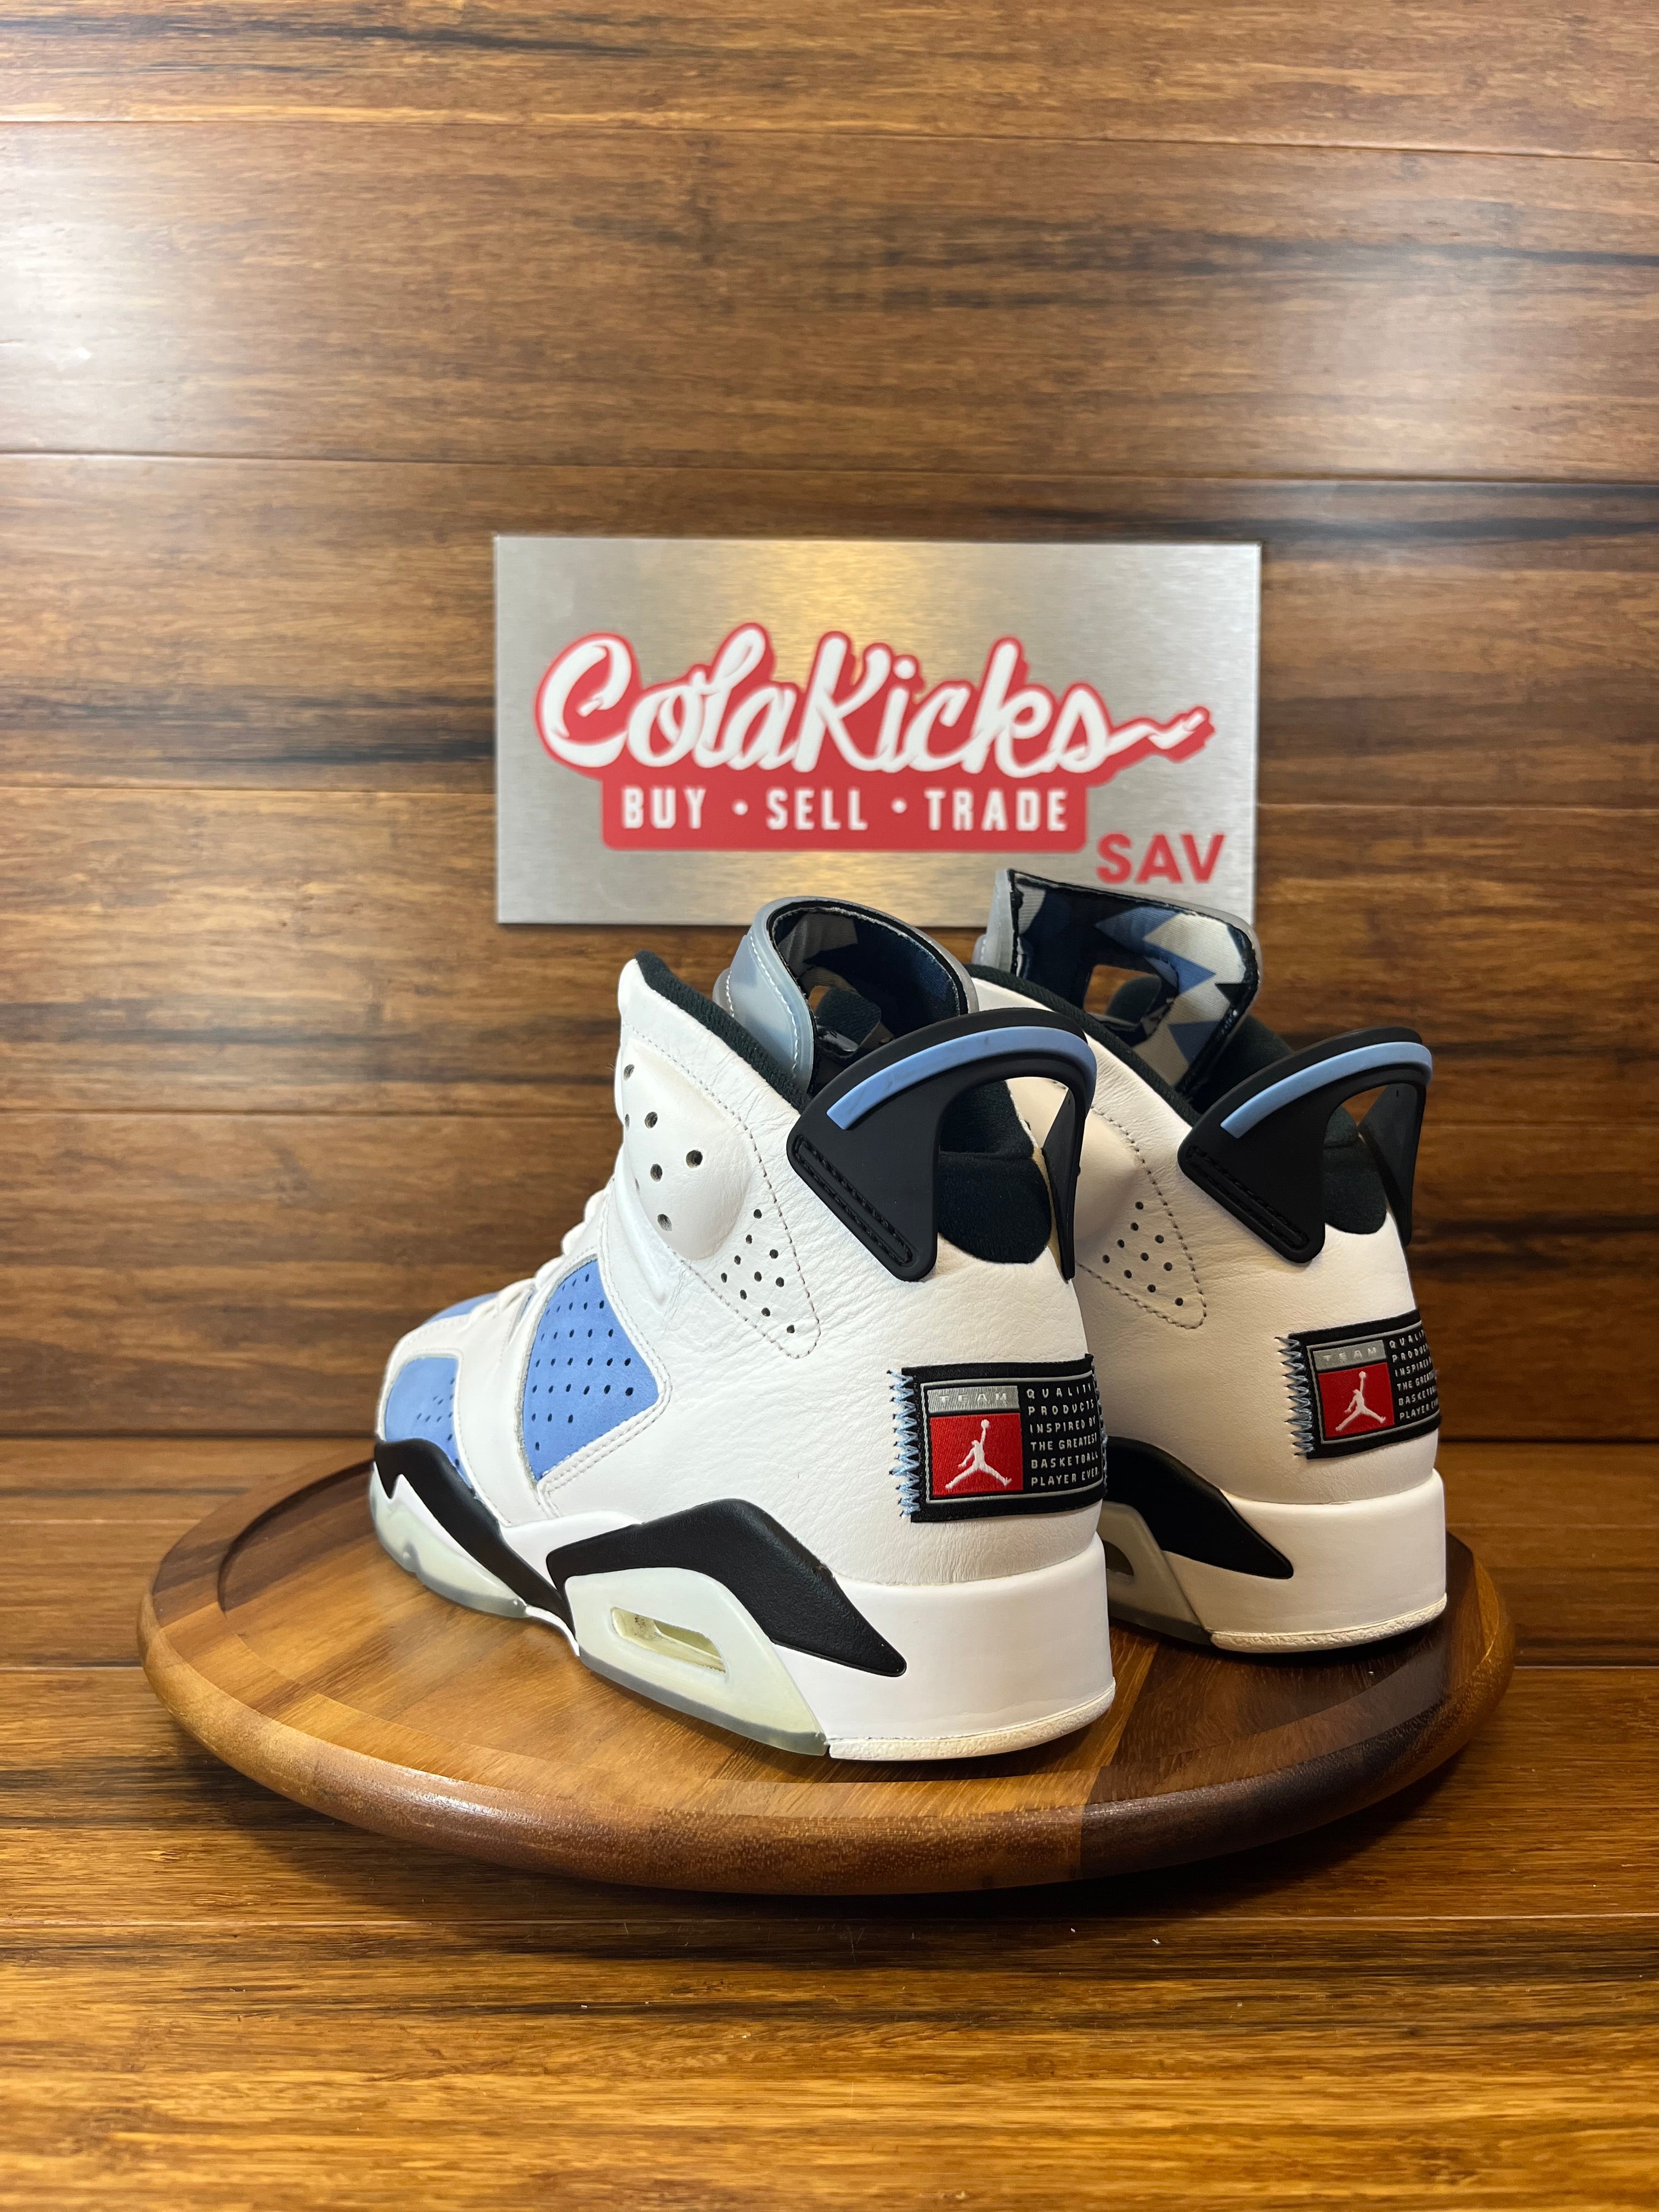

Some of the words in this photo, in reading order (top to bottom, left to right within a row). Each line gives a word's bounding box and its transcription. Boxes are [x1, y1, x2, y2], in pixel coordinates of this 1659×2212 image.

[542, 625, 1206, 779] ColaKicks
[621, 787, 706, 830] BUY
[766, 788, 868, 831] SELL
[925, 788, 1069, 831] TRADE
[1097, 833, 1226, 884] SAV
[1389, 1329, 1425, 1349] QUALIT
[1323, 1347, 1377, 1362] TEAM
[1392, 1343, 1428, 1363] PRODUC
[1026, 1383, 1092, 1400] QUALITY
[1397, 1380, 1413, 1391] THE
[939, 1392, 1007, 1406] TEAM
[1028, 1399, 1094, 1416] PRODUCTS
[1400, 1403, 1429, 1421] PLAYER
[1030, 1419, 1086, 1434] INSPIRED
[1088, 1415, 1096, 1427] BY
[1030, 1441, 1053, 1452] THE
[1058, 1432, 1097, 1451] GREATEST
[1031, 1451, 1098, 1469] BASKETBALL
[1031, 1473, 1077, 1487] PLAYER
